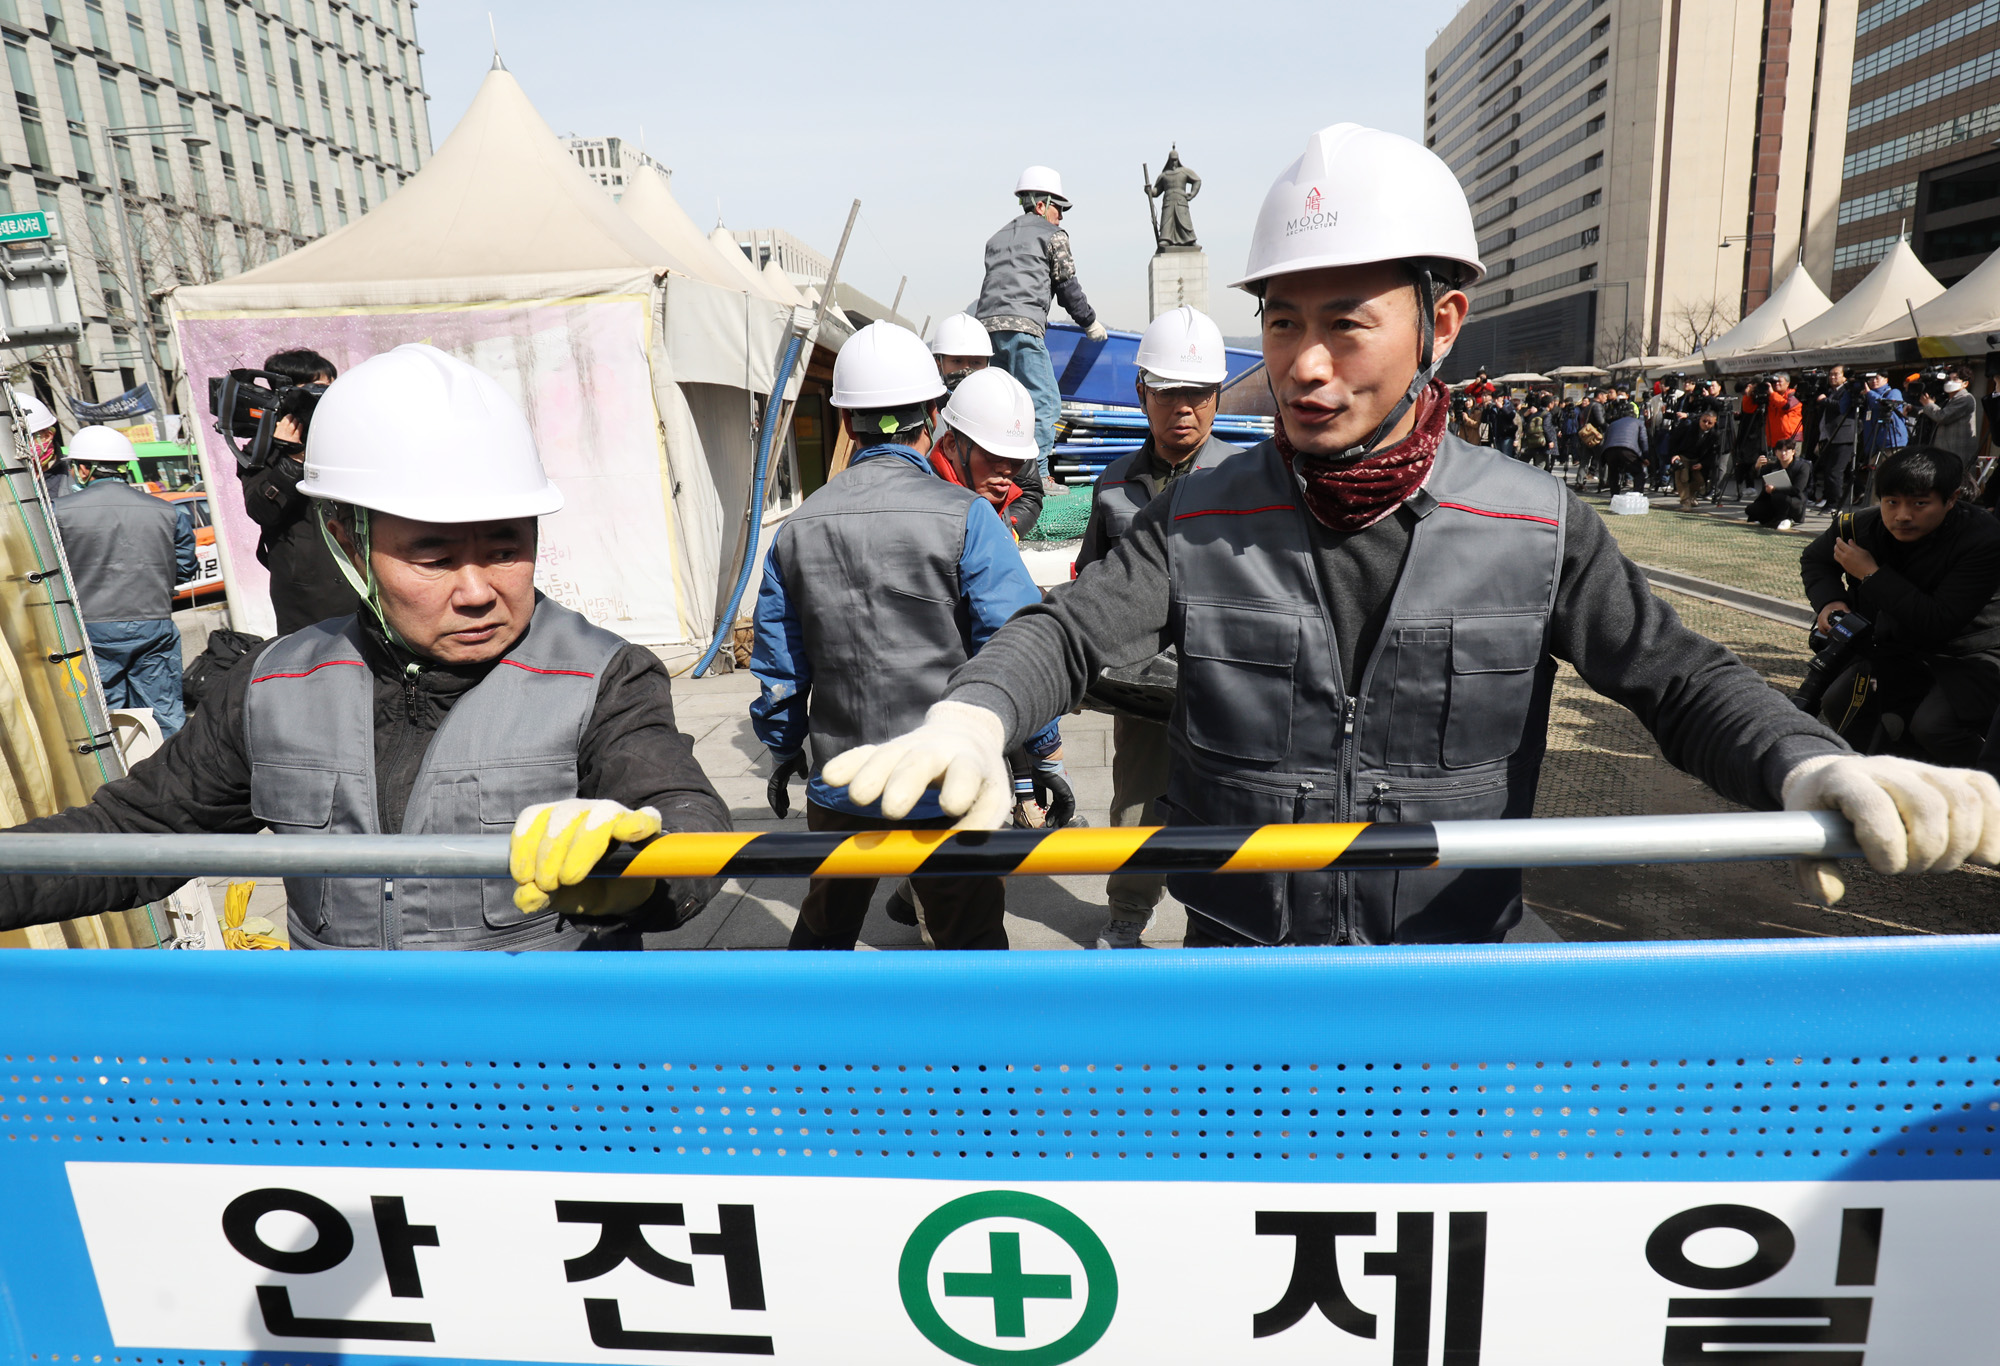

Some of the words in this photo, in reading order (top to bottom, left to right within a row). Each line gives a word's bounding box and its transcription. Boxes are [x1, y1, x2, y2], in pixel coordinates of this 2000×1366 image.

[1286, 211, 1338, 231] MOON
[1286, 222, 1336, 237] ARCHITECTURE
[222, 1187, 775, 1356] 안전
